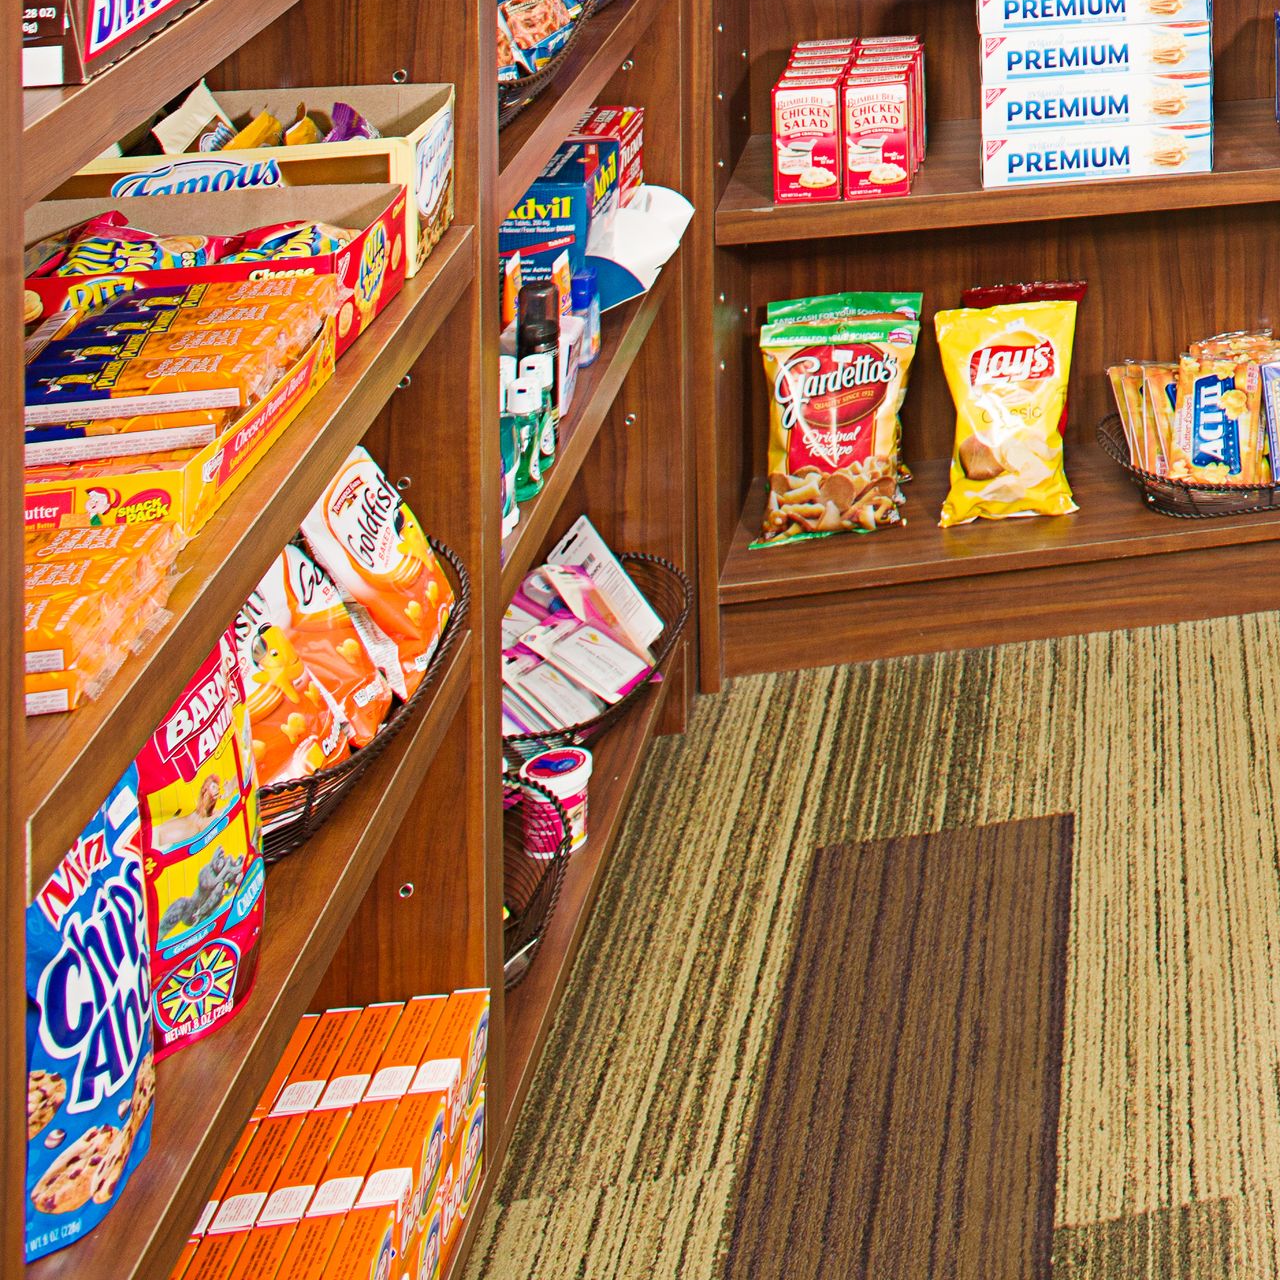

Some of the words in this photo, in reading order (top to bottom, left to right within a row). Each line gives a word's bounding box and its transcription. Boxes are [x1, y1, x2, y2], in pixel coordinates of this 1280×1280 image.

[38, 7, 56, 19] OZ)
[1007, 43, 1129, 71] PREMIUM
[777, 96, 809, 110] BUMBLE
[811, 96, 824, 104] BEE
[847, 93, 880, 108] BUMBLE
[881, 92, 894, 101] BEE
[851, 103, 901, 118] CHICKEN
[1007, 94, 1129, 121] PREMIUM
[781, 107, 831, 121] CHICKEN
[784, 118, 829, 131] SALAD
[854, 114, 899, 129] SALAD
[620, 129, 644, 176] TYLENOL
[1007, 145, 1131, 173] PREMIUM
[112, 158, 283, 198] Famous
[592, 150, 616, 208] Advil
[548, 237, 572, 247] Tablets
[248, 267, 315, 282] Cheese
[797, 314, 818, 322] CASH
[819, 312, 834, 320] FOR
[834, 308, 857, 319] YOUR
[974, 344, 1051, 385] Lay's
[775, 352, 898, 429] Gardetto's
[813, 399, 841, 410] QUALITY
[842, 393, 861, 403] SINCE
[861, 390, 874, 398] 1932
[234, 416, 261, 452] Cheese
[267, 386, 289, 418] Peanut
[288, 366, 309, 397] Butter
[802, 425, 862, 443] Original
[1199, 410, 1225, 461] ACT
[24, 506, 59, 520] utter
[117, 496, 162, 518] SNACK
[126, 503, 170, 524] PACK
[347, 472, 397, 569] Goldfish
[378, 526, 392, 560] BAKED
[44, 861, 145, 1049] Chips
[173, 929, 209, 956] GORILLA
[76, 950, 151, 1104] Aho
[165, 1027, 179, 1044] NET
[193, 1018, 200, 1030] 8
[201, 1010, 213, 1026] OZ
[212, 997, 234, 1021] (226g)
[49, 1228, 59, 1242] OZ
[60, 1218, 82, 1239] (226g)
